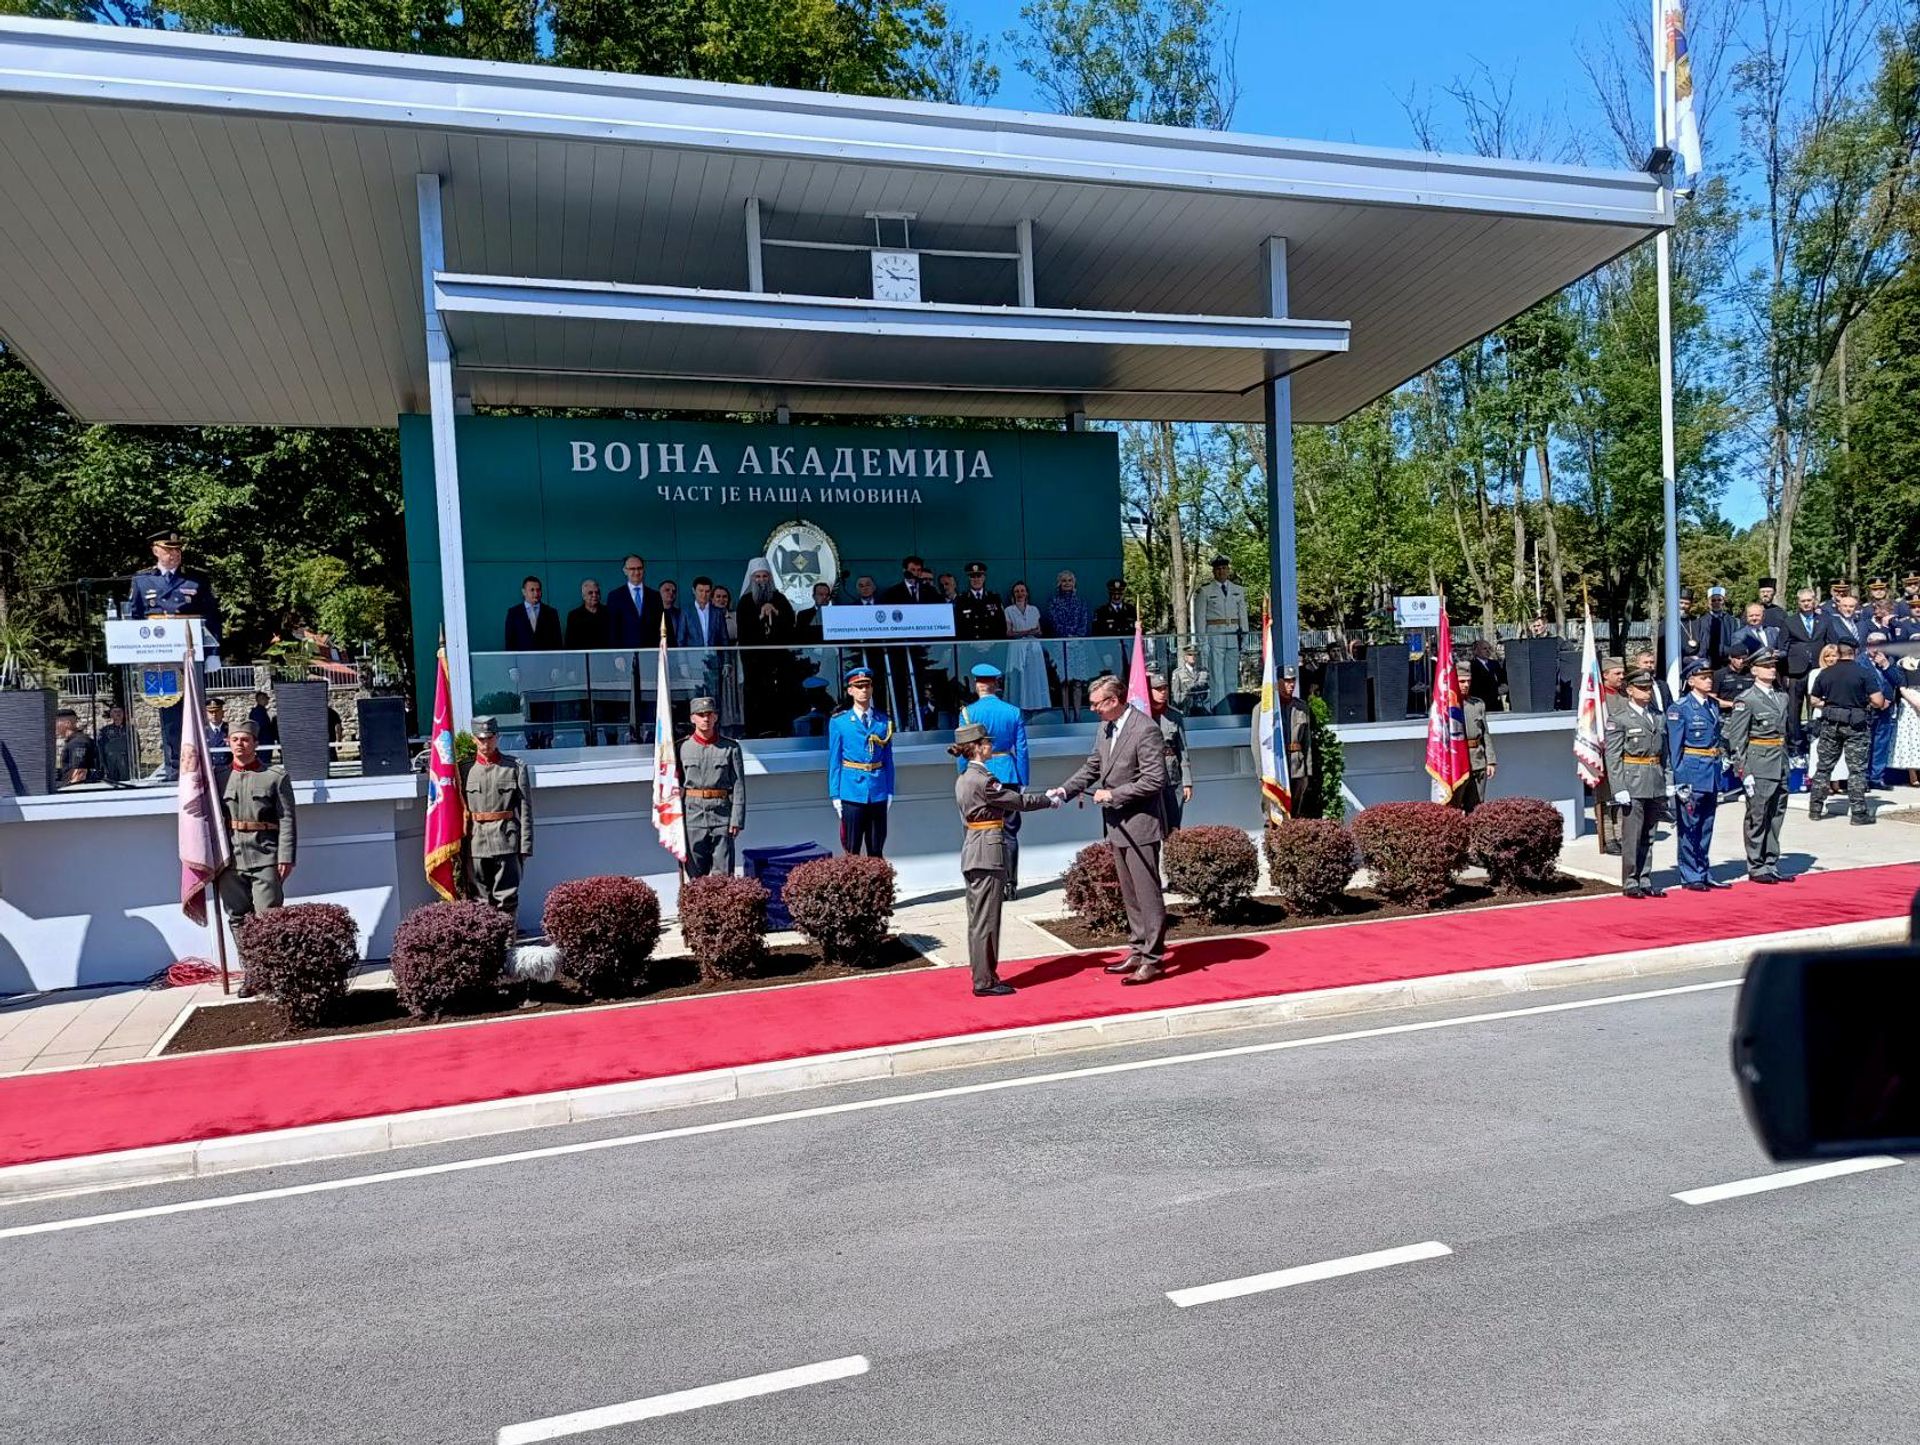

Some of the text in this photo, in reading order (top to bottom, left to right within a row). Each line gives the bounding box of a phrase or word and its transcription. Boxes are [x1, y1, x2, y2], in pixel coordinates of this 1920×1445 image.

[569, 441, 994, 484] ВОЈНА АКАДЕМИЈА
[657, 486, 922, 505] ЧАСТ ЈЕ НАША ИМОВИНА
